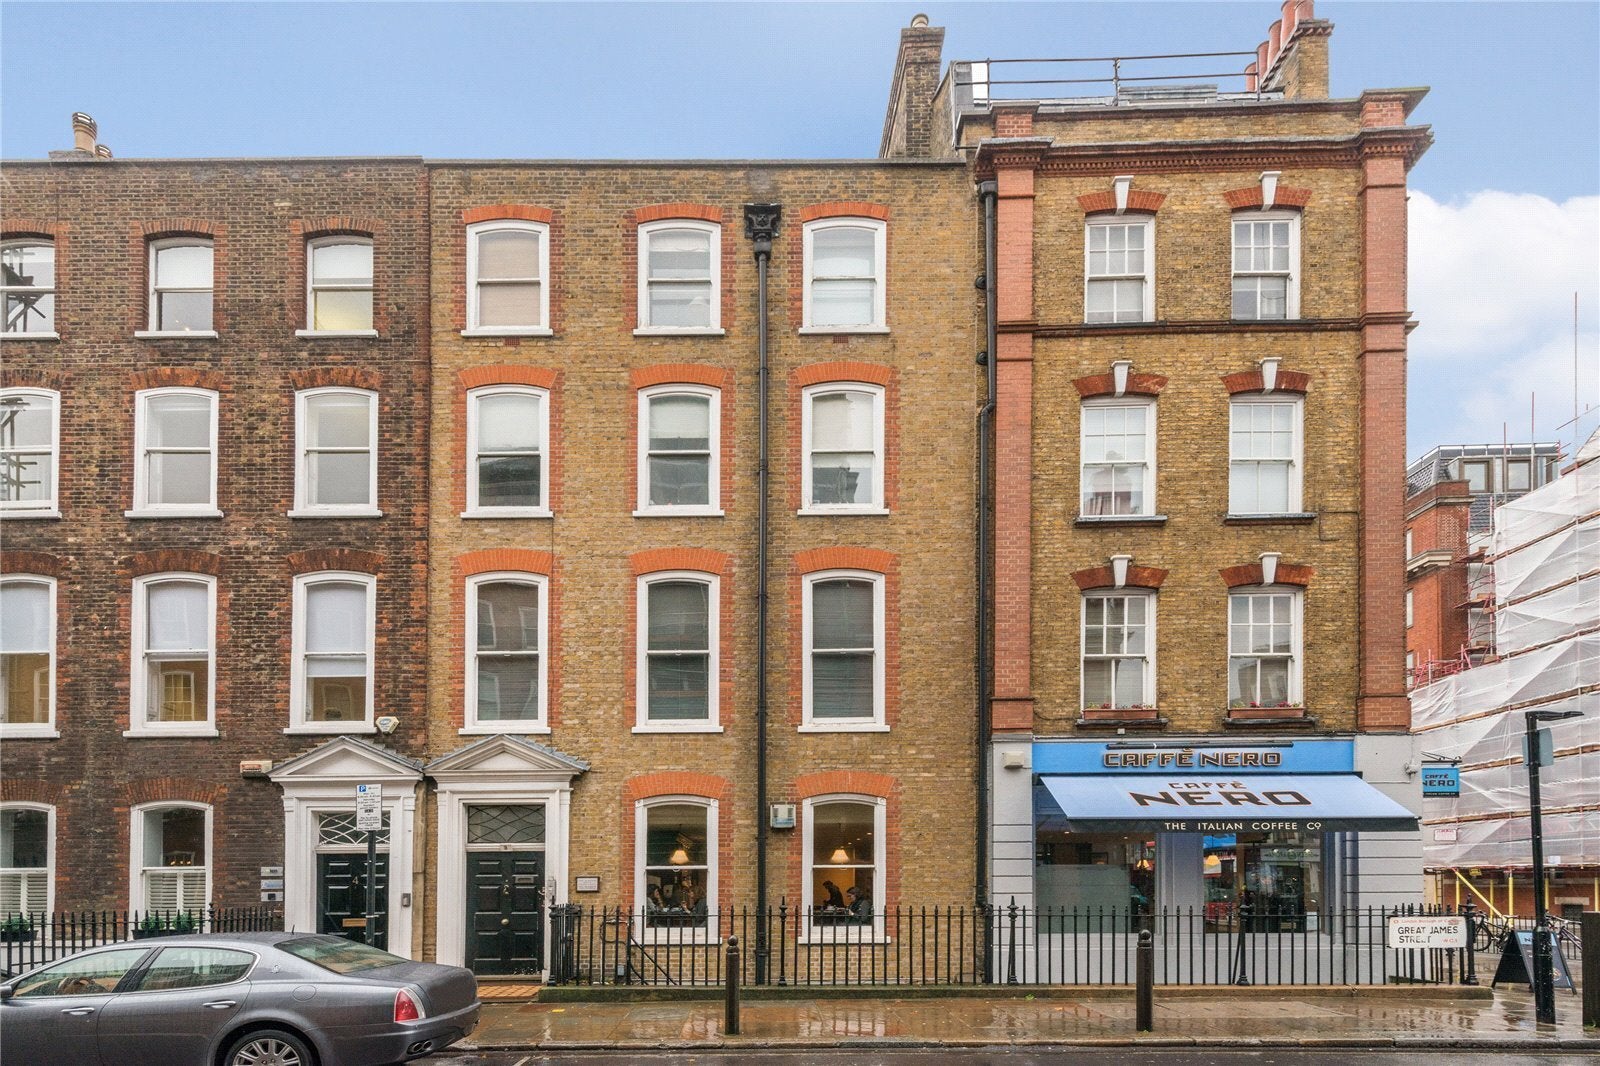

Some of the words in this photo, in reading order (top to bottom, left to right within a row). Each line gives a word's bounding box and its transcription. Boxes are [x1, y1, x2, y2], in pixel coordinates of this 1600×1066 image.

[1104, 748, 1194, 767] CAFFÈ
[1200, 752, 1282, 767] NERO
[1168, 781, 1247, 789] CAFFÈ
[1129, 791, 1312, 806] NERO
[1165, 822, 1186, 830] THE
[1198, 822, 1243, 830] ITALIAN
[1252, 822, 1298, 830] COFFEE
[352, 876, 359, 884] 4
[1397, 926, 1426, 934] GREAT
[1429, 926, 1459, 934] JAMES
